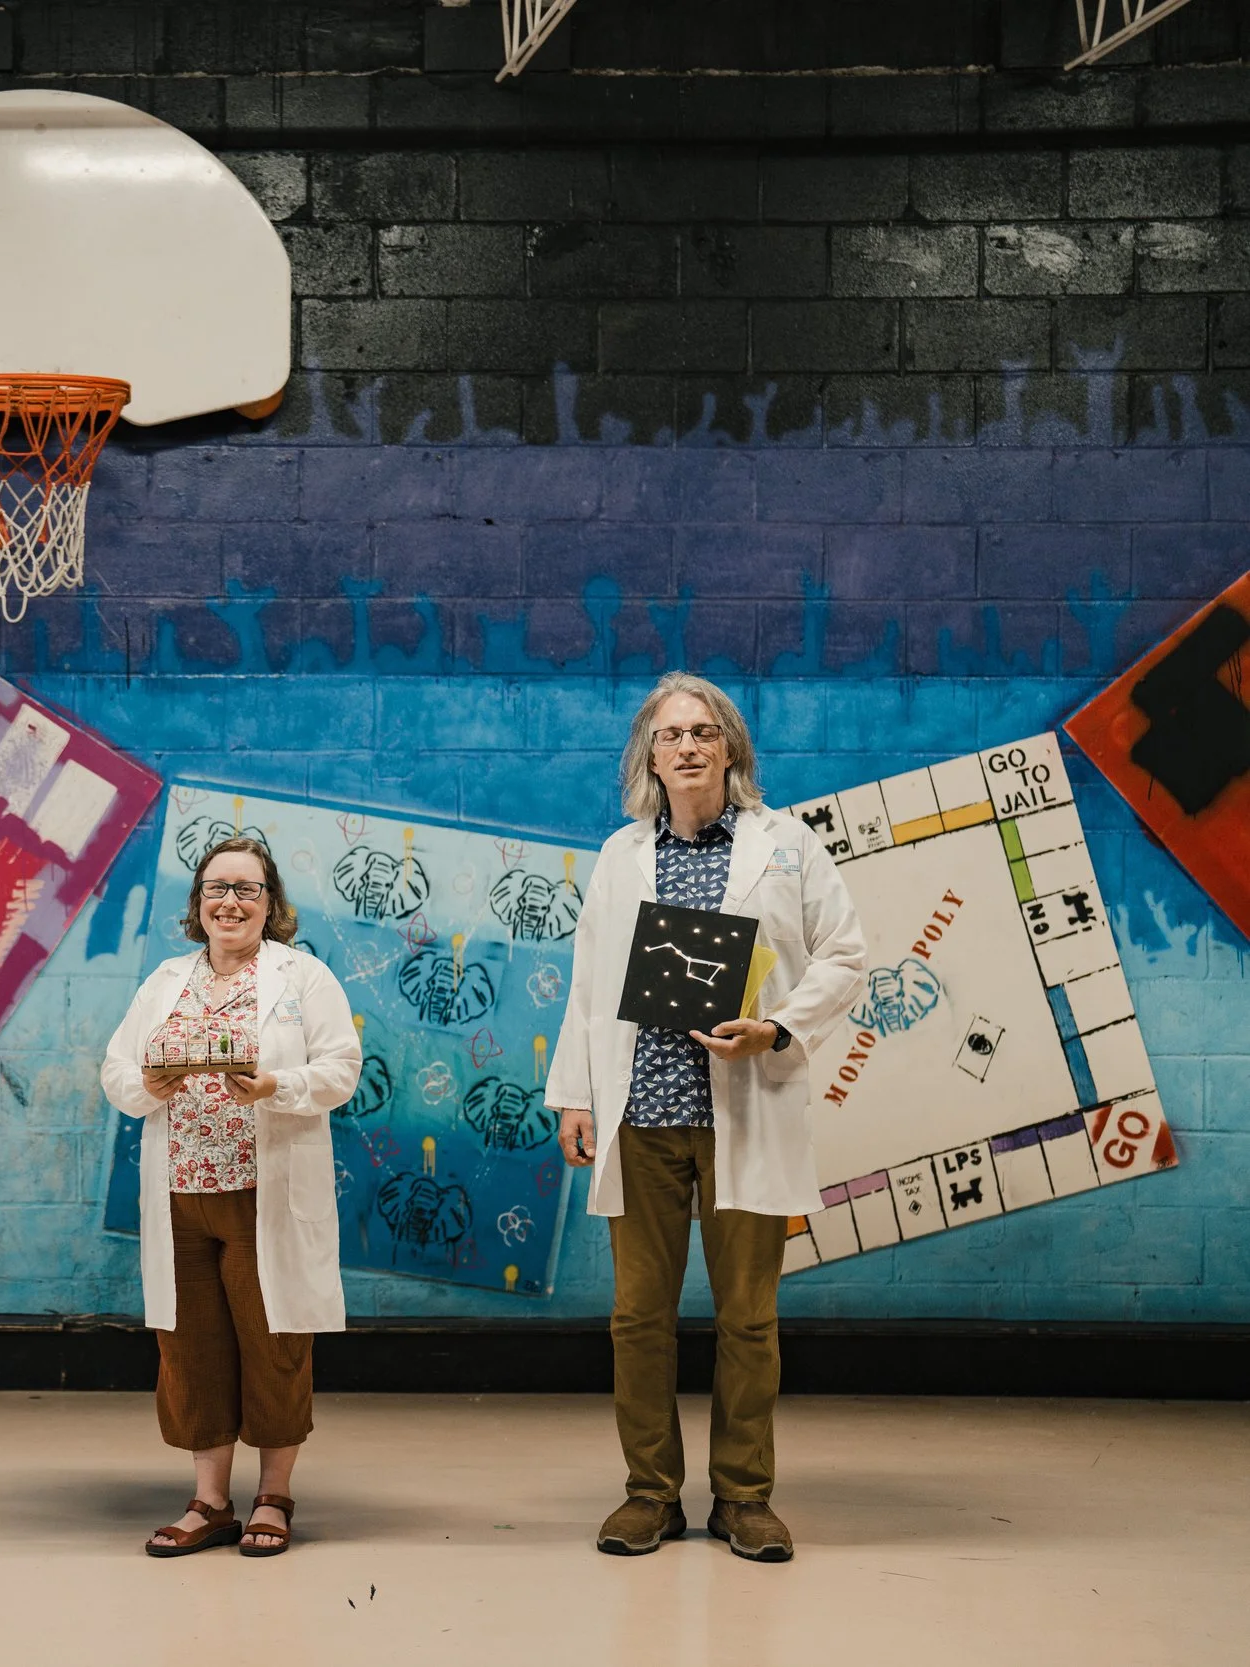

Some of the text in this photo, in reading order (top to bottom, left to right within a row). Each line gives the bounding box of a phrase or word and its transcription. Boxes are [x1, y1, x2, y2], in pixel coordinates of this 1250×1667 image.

[988, 748, 1026, 773] GO
[1015, 764, 1050, 787] TO
[1001, 785, 1056, 814] JAIL
[911, 888, 964, 960] POLY
[824, 1031, 876, 1107] MONO
[1103, 1111, 1149, 1169] GO
[943, 1149, 982, 1174] LPS
